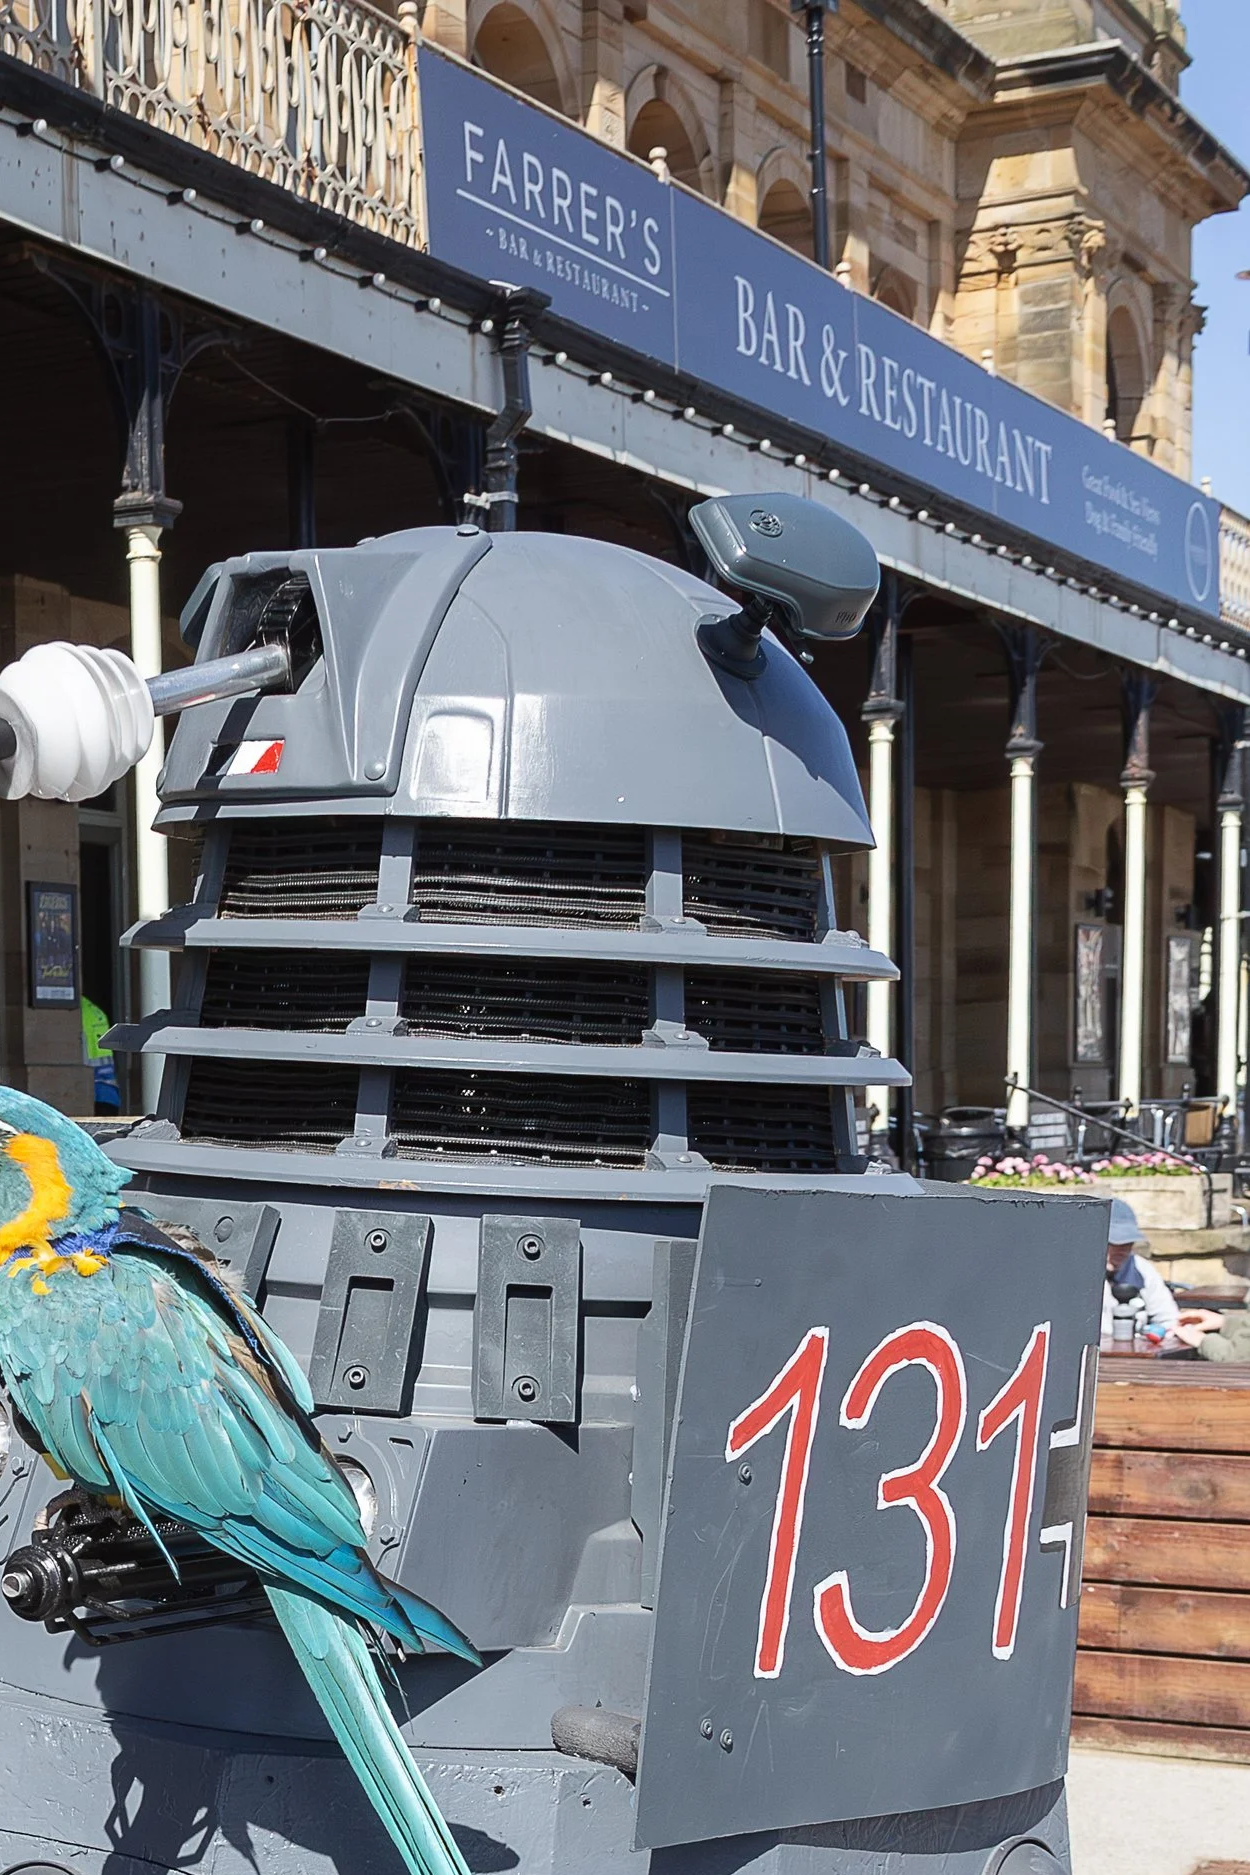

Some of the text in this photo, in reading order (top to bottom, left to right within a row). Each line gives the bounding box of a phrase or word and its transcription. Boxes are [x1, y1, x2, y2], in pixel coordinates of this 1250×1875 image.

[463, 120, 661, 276] FARRER'S
[498, 227, 639, 313] BAR & RESTAURANT
[733, 275, 1053, 505] BAR & RESTAURANT
[725, 1319, 1051, 1681] 131
